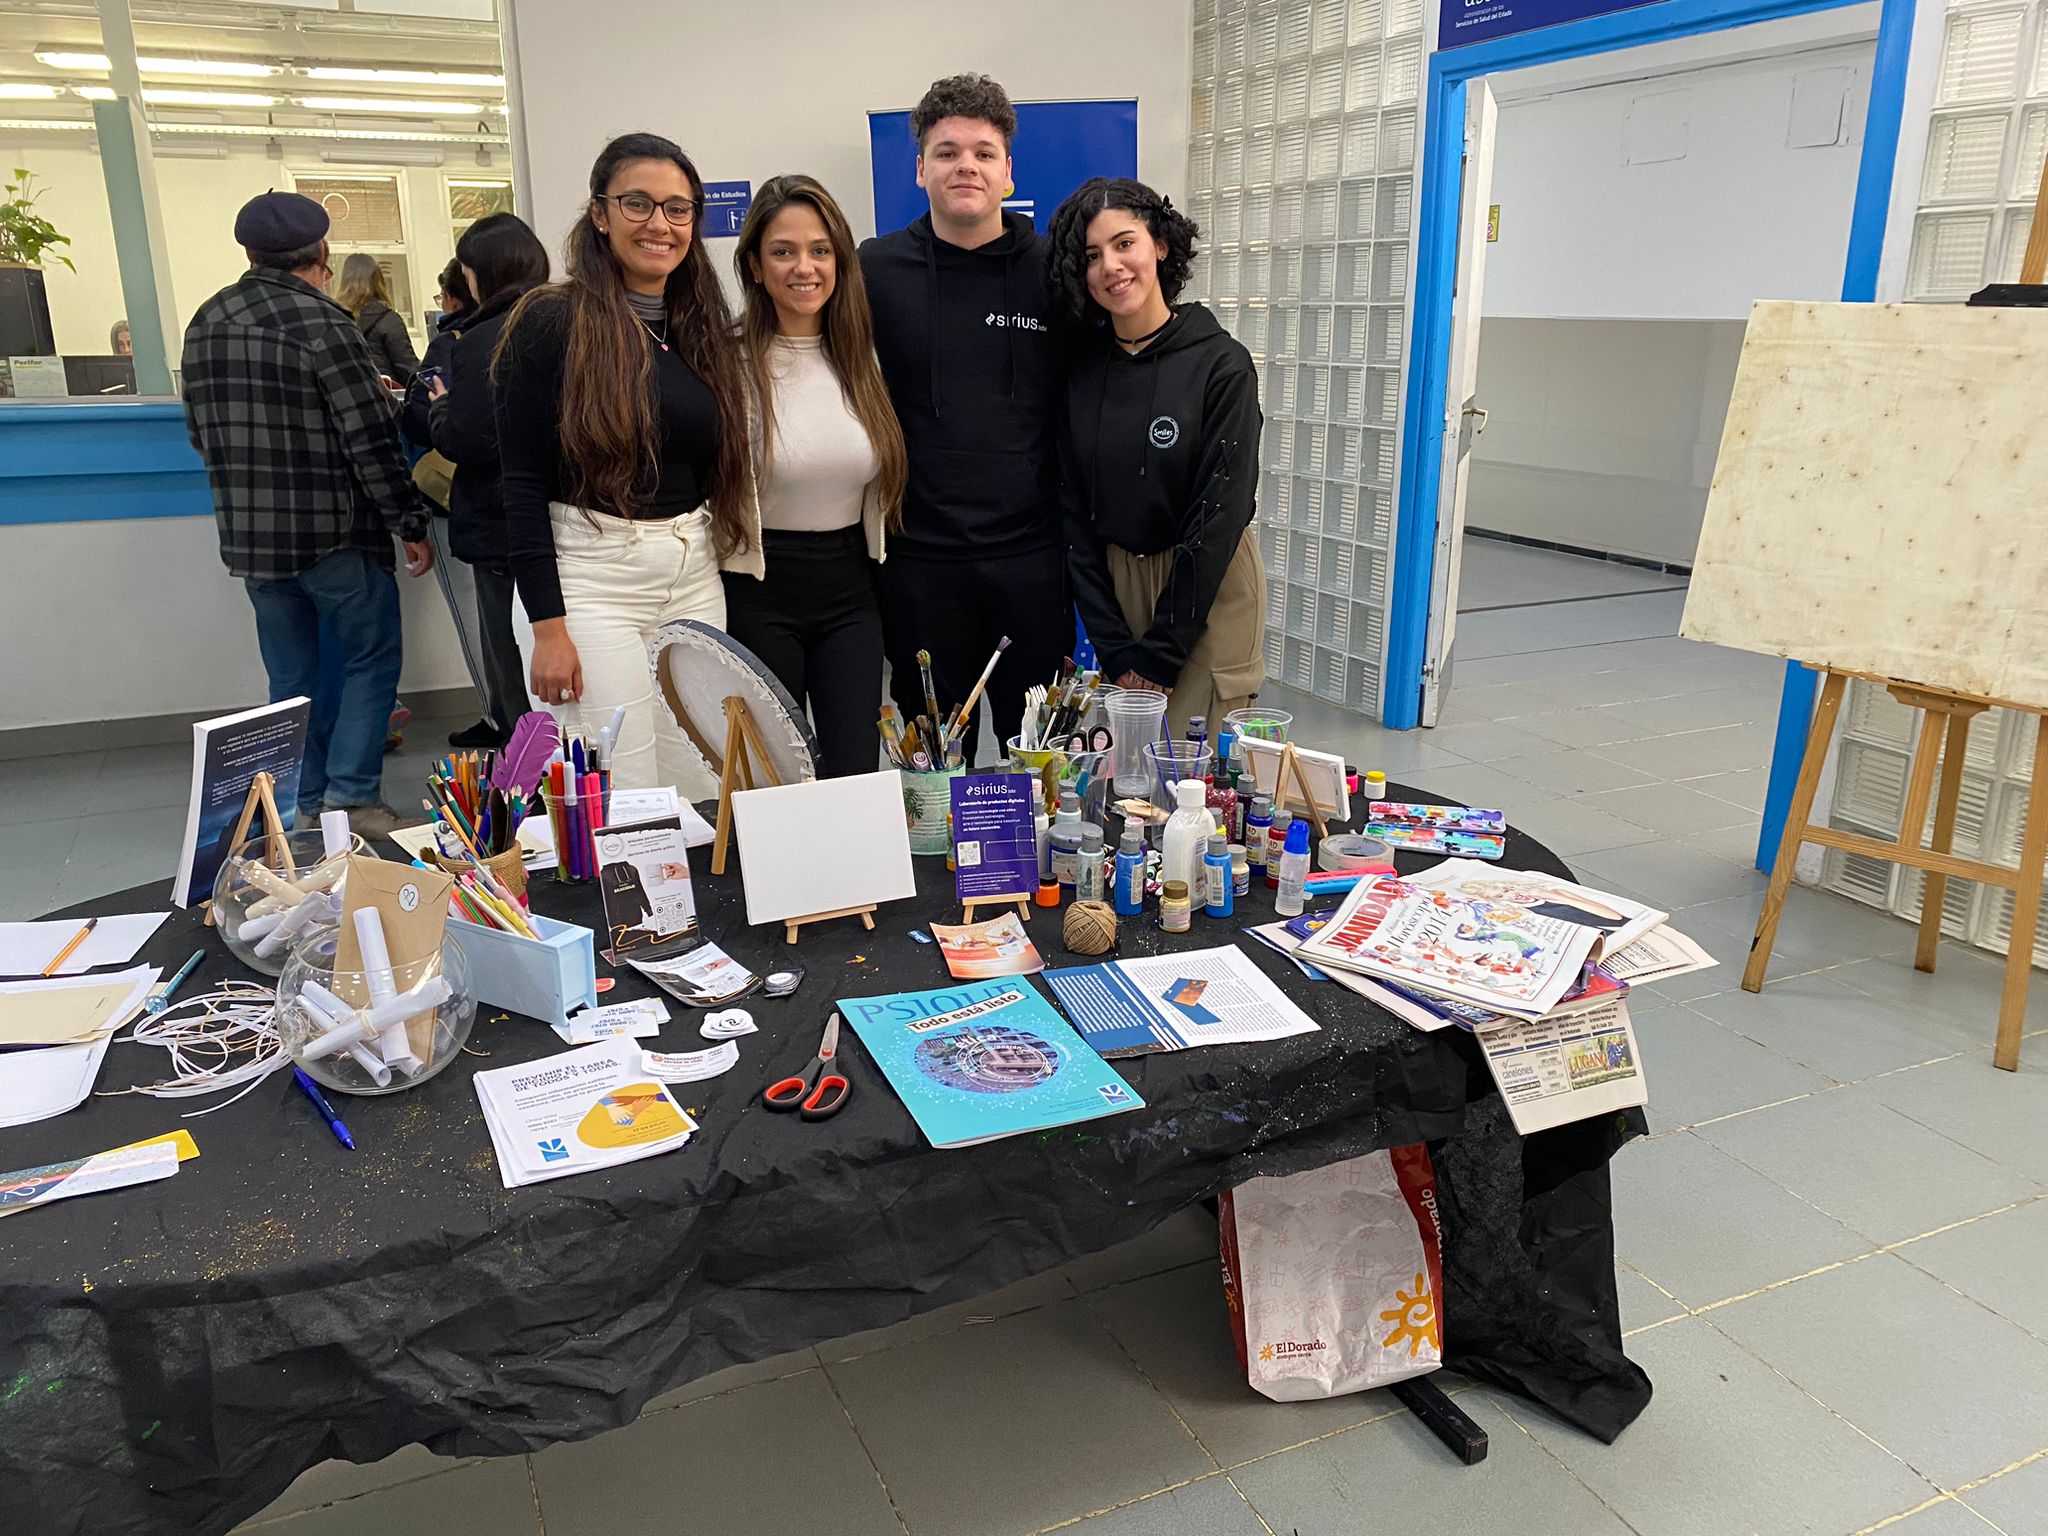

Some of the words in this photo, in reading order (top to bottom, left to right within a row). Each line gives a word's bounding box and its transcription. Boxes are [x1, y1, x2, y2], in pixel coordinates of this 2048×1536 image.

[1455, 19, 1473, 28] Servicios
[1479, 15, 1490, 23] Salud
[1498, 10, 1513, 18] Estado
[721, 191, 747, 199] Estudios
[996, 312, 1038, 330] sirius
[973, 783, 1008, 796] sirius
[1326, 878, 1402, 950] VANIDAD
[1417, 907, 1452, 945] 2014
[907, 1016, 949, 1032] Todo
[952, 1004, 985, 1020] está
[987, 992, 1018, 1010] listo
[511, 1068, 563, 1084] PREVENIR
[513, 1072, 562, 1088] SUICIDIO
[581, 1058, 615, 1071] TAREA
[534, 1075, 571, 1089] TODOS
[583, 1062, 622, 1074] TODAS.
[1502, 1065, 1534, 1079] canelones
[1276, 1342, 1288, 1353] El
[1287, 1339, 1327, 1352] Dorado
